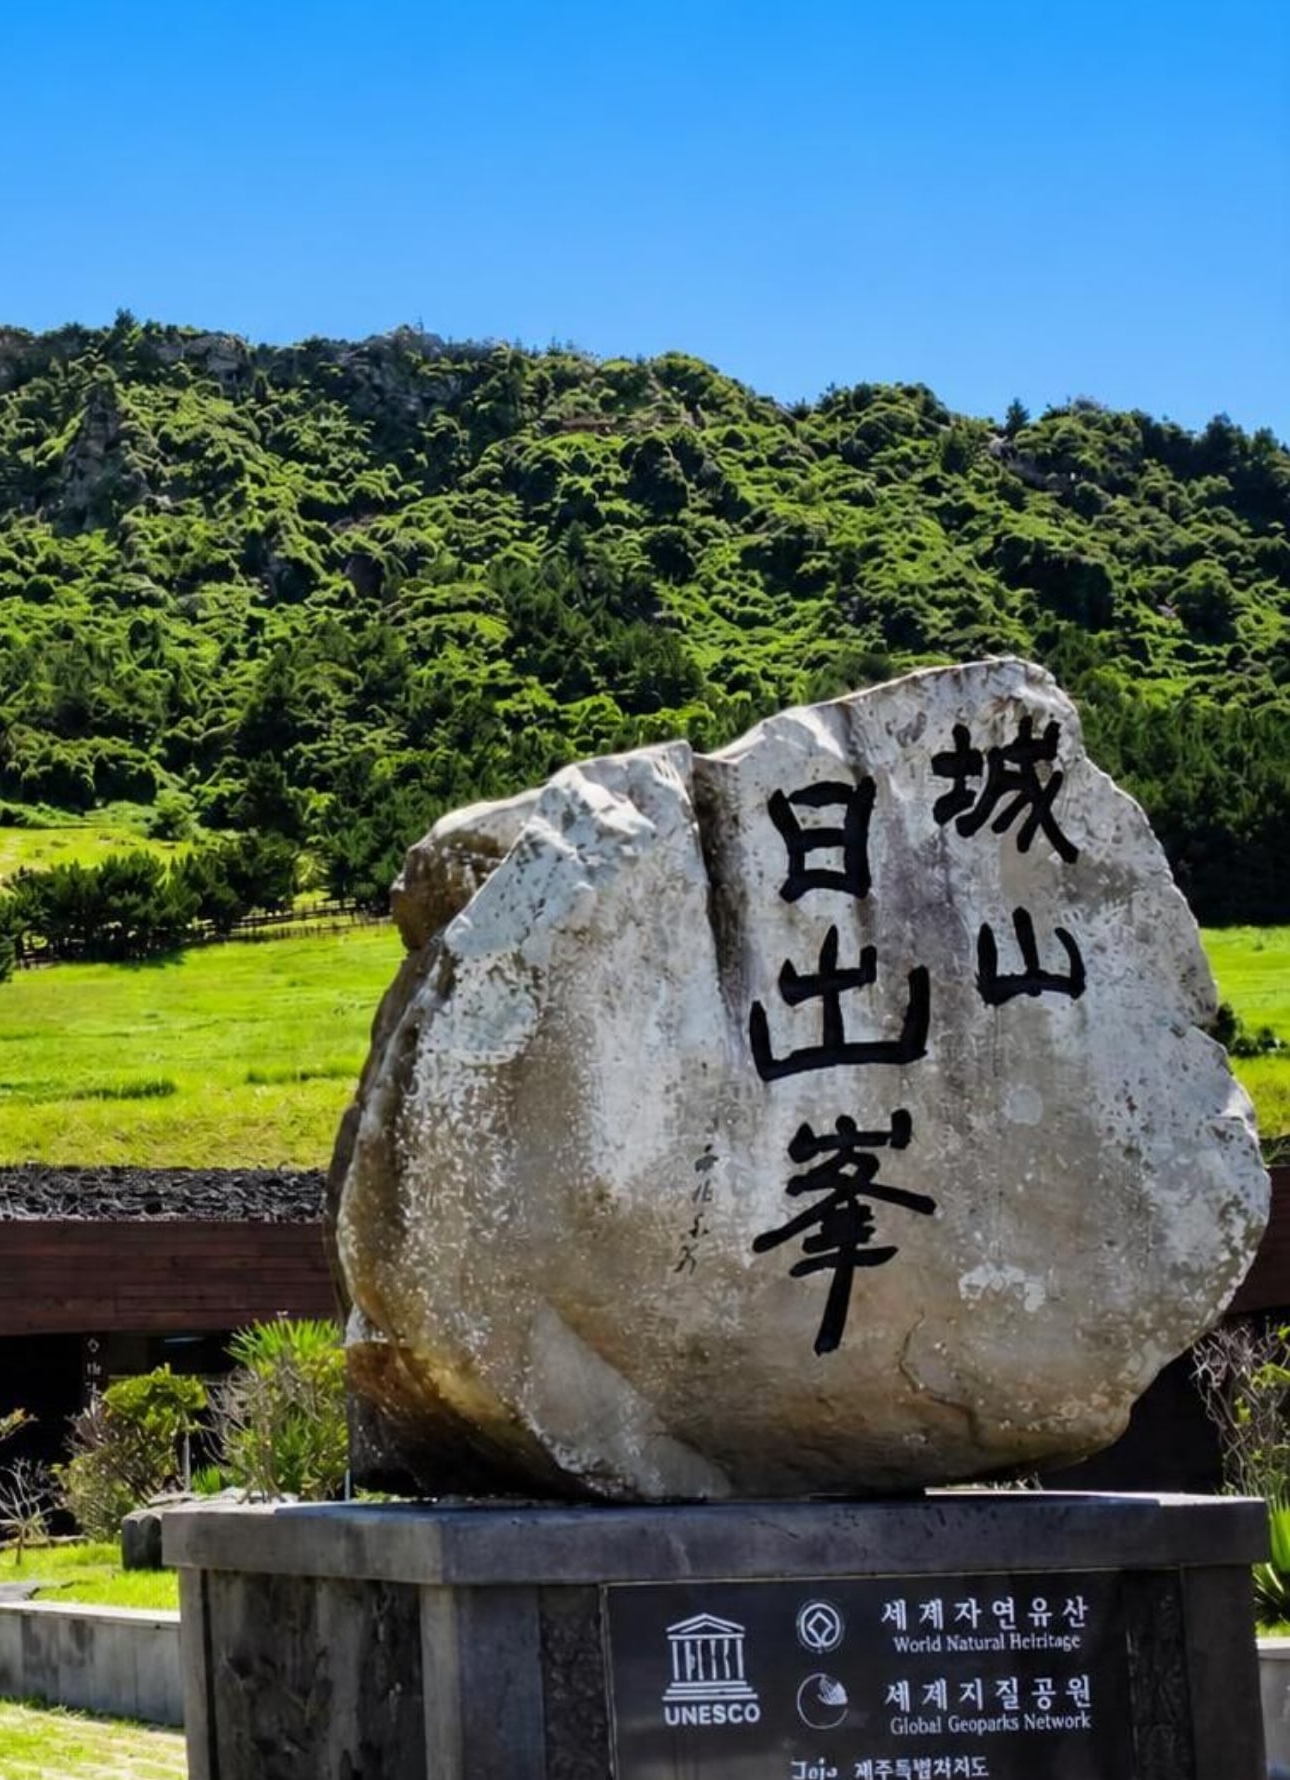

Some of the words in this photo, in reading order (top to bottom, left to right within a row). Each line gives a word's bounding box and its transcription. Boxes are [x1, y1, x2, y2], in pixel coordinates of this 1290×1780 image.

[931, 715, 1086, 1005] 城山
[893, 1636, 942, 1652] World
[946, 1633, 1005, 1651] Natural
[664, 1703, 761, 1726] UNESCO
[890, 1716, 942, 1735] Global
[948, 1713, 1019, 1735] Geoparks
[1024, 1711, 1091, 1730] Network
